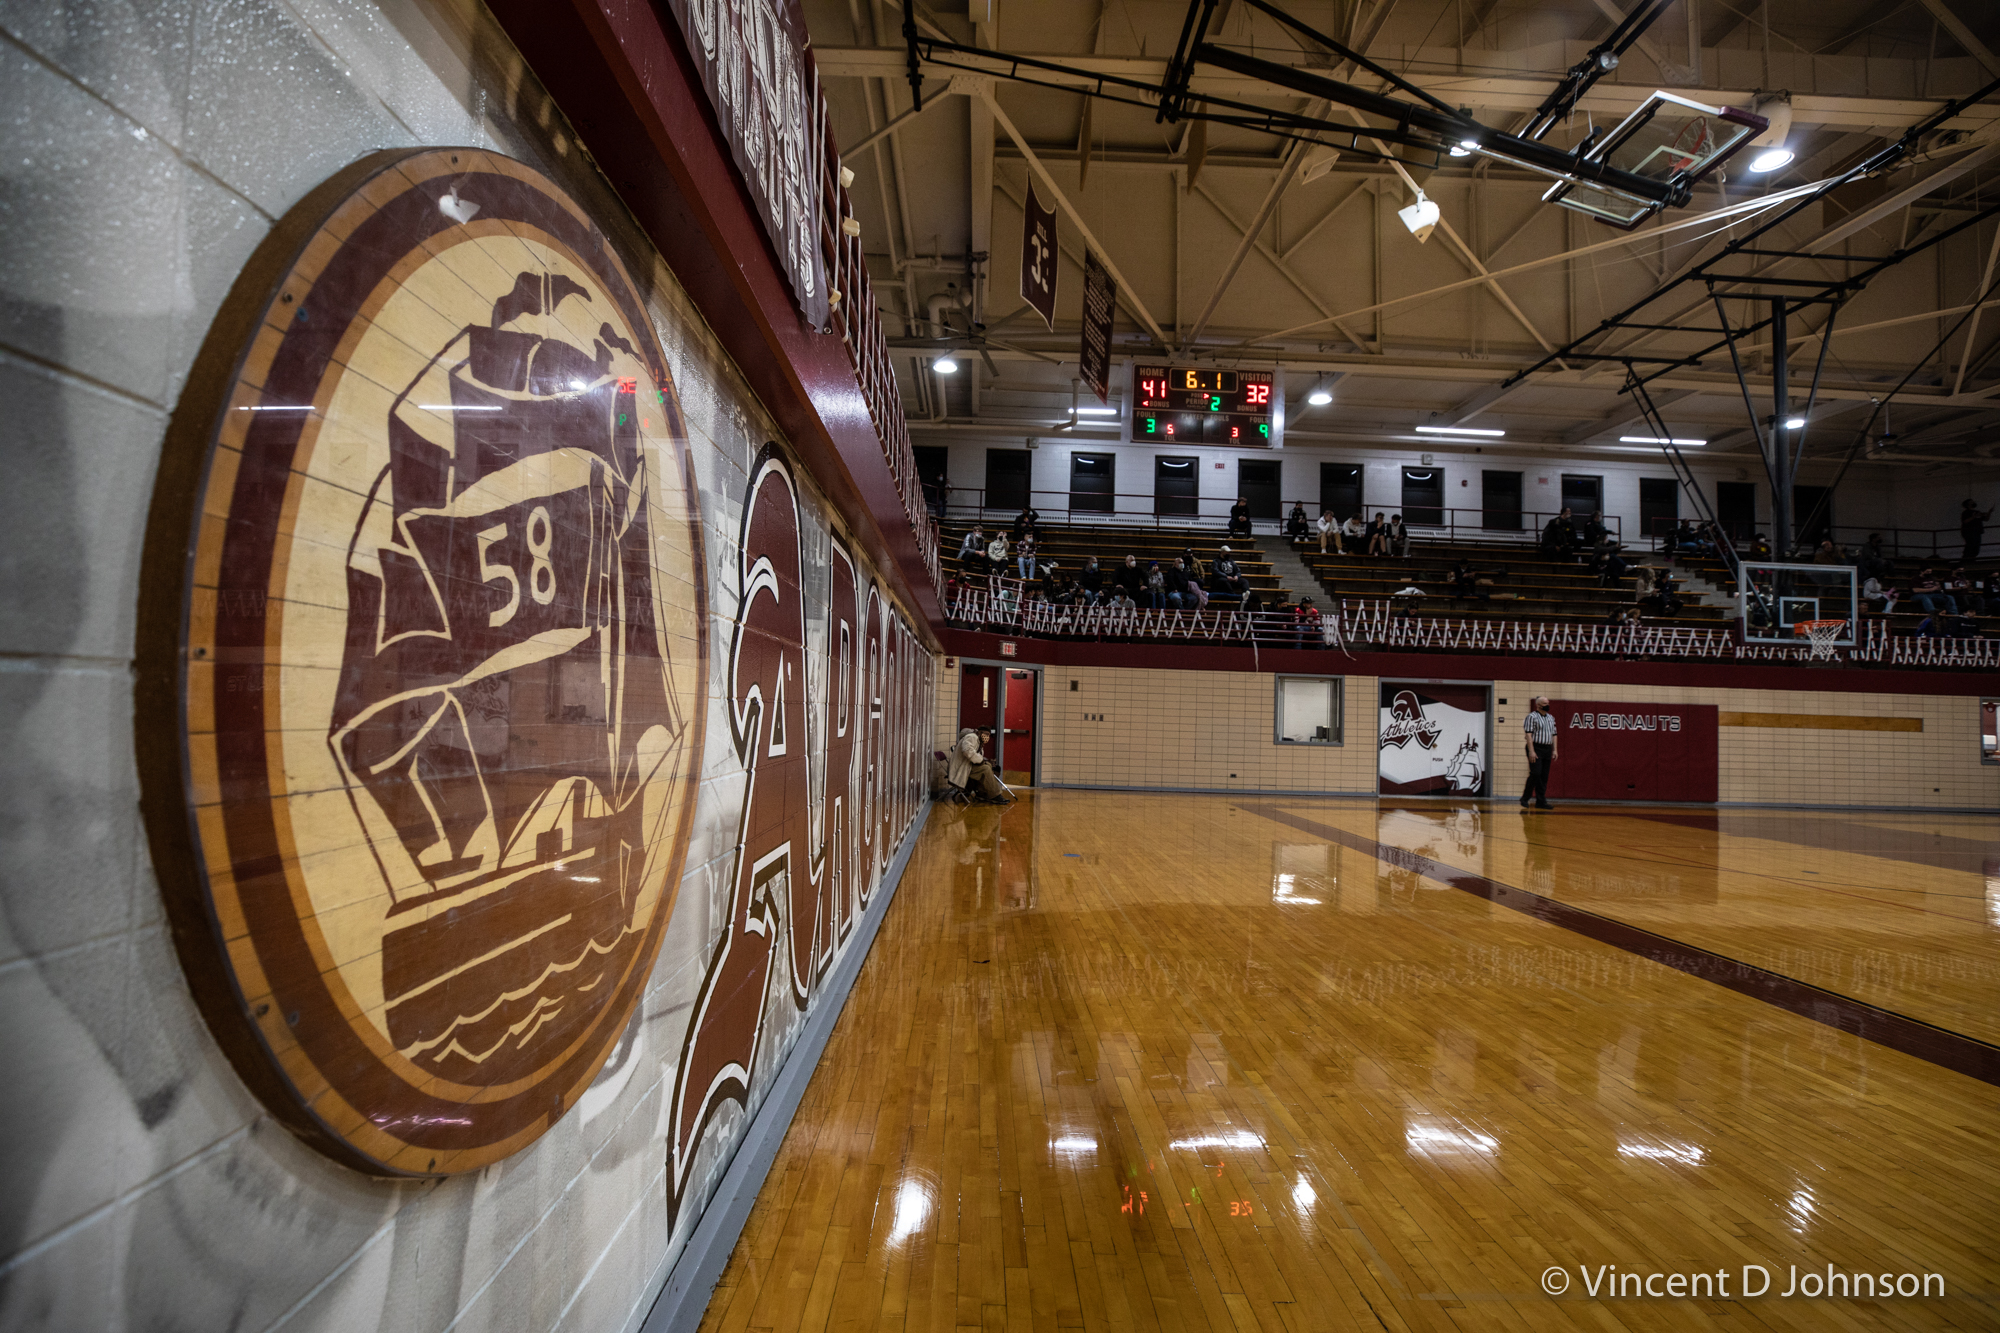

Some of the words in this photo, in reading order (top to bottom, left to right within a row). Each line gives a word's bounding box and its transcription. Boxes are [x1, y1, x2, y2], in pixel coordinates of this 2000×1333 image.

[1140, 367, 1164, 377] HOME
[1240, 372, 1272, 382] VISITOR
[1186, 370, 1221, 390] 6.1
[1142, 379, 1166, 398] 41
[1246, 384, 1269, 403] 32
[1210, 396, 1220, 411] 2
[1236, 404, 1257, 412] BONUS
[1146, 418, 1155, 433] 3
[1210, 414, 1230, 422] FOULS
[1166, 423, 1174, 434] 5
[1231, 427, 1239, 438] 3
[1259, 423, 1268, 439] 9
[1164, 434, 1175, 442] TOL
[1229, 437, 1240, 445] TOL
[475, 505, 556, 628] 58
[1569, 712, 1681, 732] ARGONAUTS
[1380, 720, 1437, 740] Athletics
